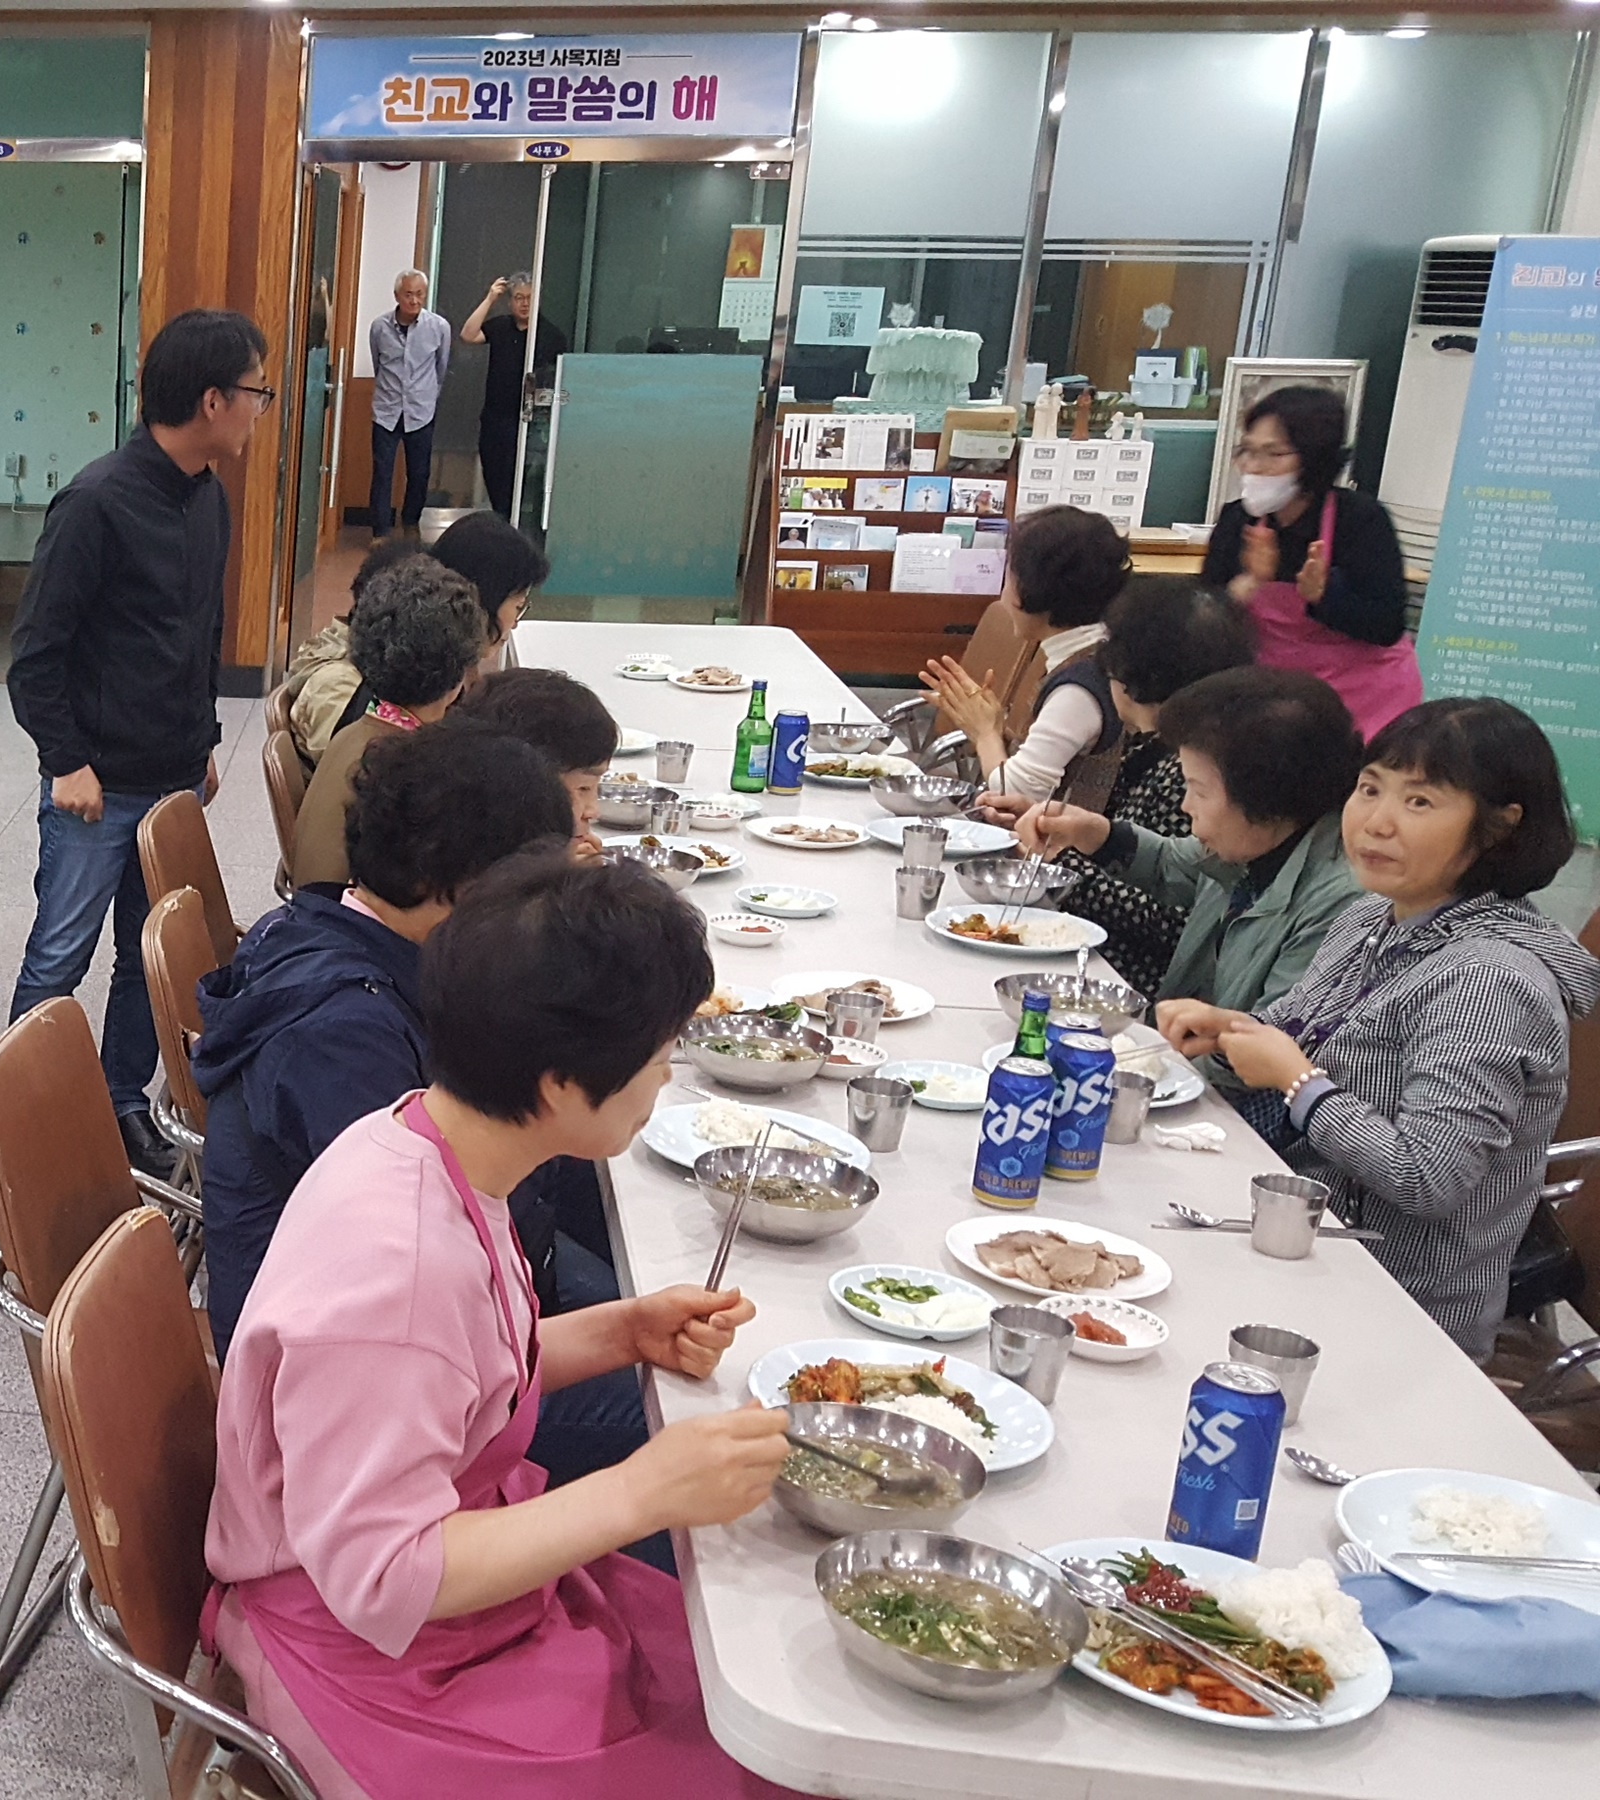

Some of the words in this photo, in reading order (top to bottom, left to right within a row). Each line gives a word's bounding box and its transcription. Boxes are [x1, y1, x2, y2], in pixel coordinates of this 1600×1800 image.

[483, 49, 545, 67] 2023년
[550, 48, 621, 68] 사목지침
[383, 77, 512, 123] 친교와
[527, 75, 657, 122] 말씀의
[672, 75, 718, 121] 해
[532, 145, 563, 156] 사무실
[1512, 264, 1587, 288] 친교와
